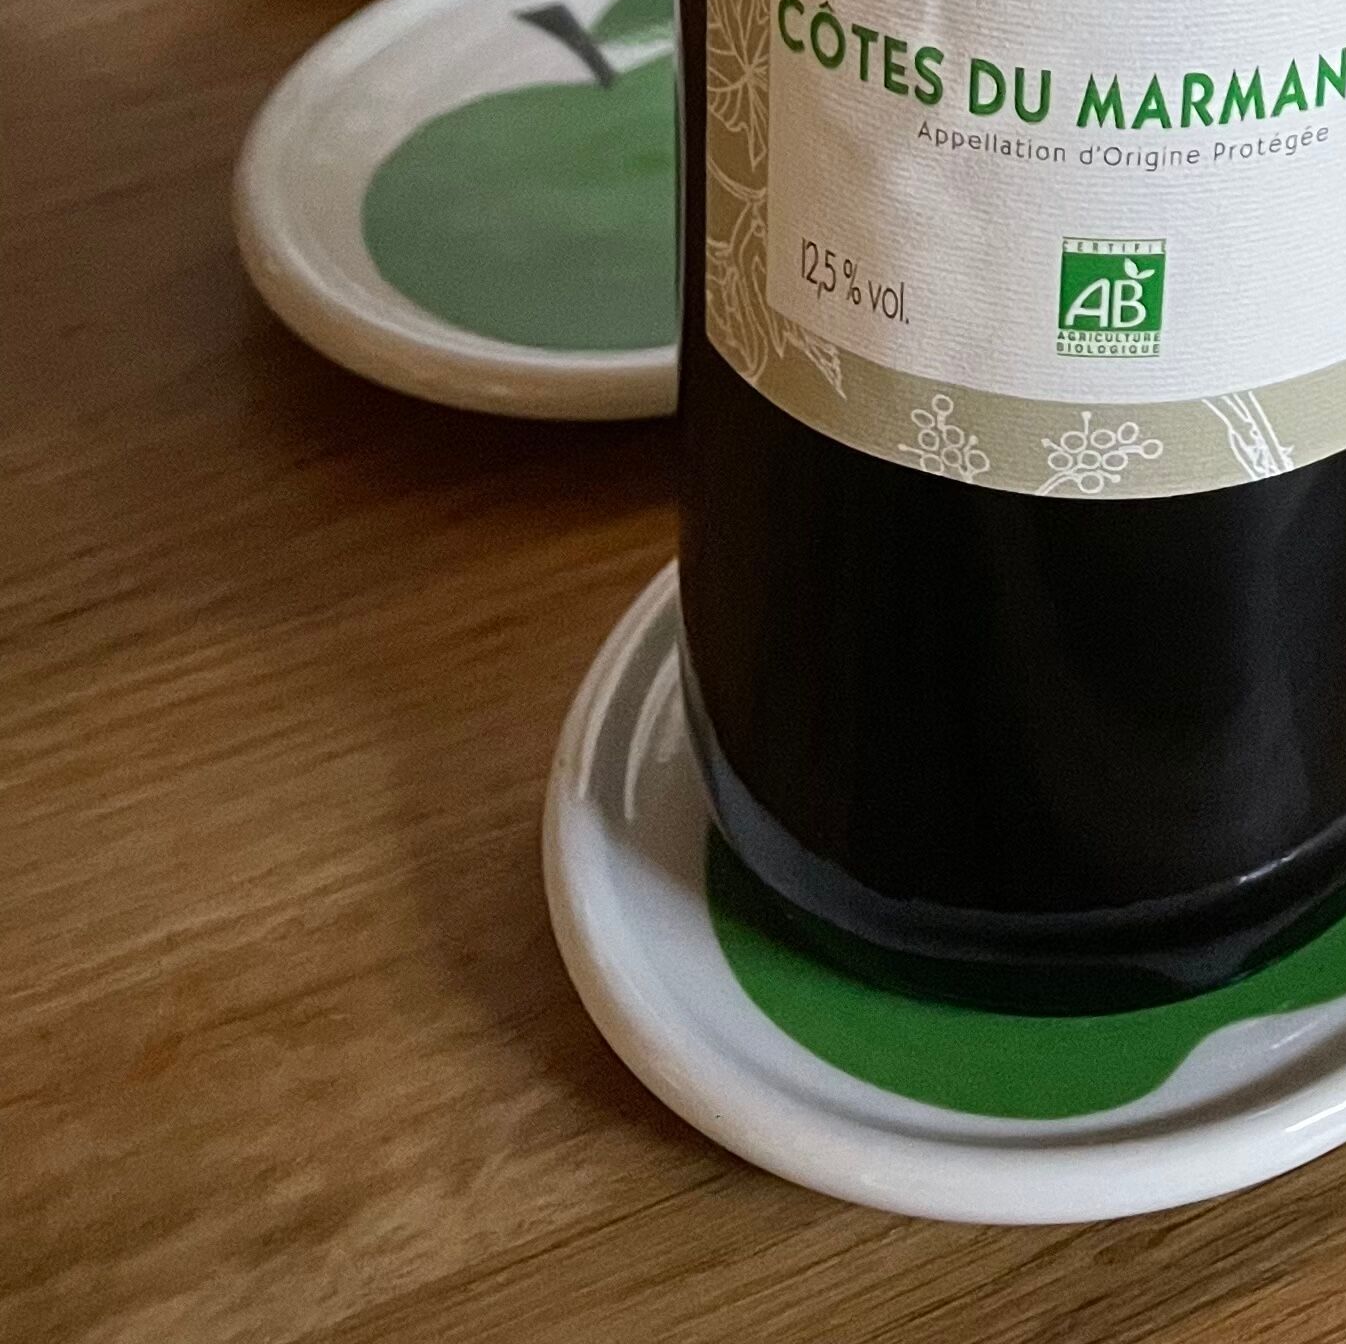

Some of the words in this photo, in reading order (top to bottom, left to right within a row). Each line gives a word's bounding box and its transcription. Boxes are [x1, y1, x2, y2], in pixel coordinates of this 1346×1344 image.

[968, 58, 1052, 123] DU
[917, 121, 1066, 162] Appellation
[1079, 145, 1200, 171] d'Origine
[1213, 124, 1329, 160] Protégée
[868, 279, 909, 324] vol.
[1065, 278, 1147, 328] AB
[1056, 342, 1160, 354] BIOLOGIQUE
[1057, 331, 1161, 343] AGRICULTURE
